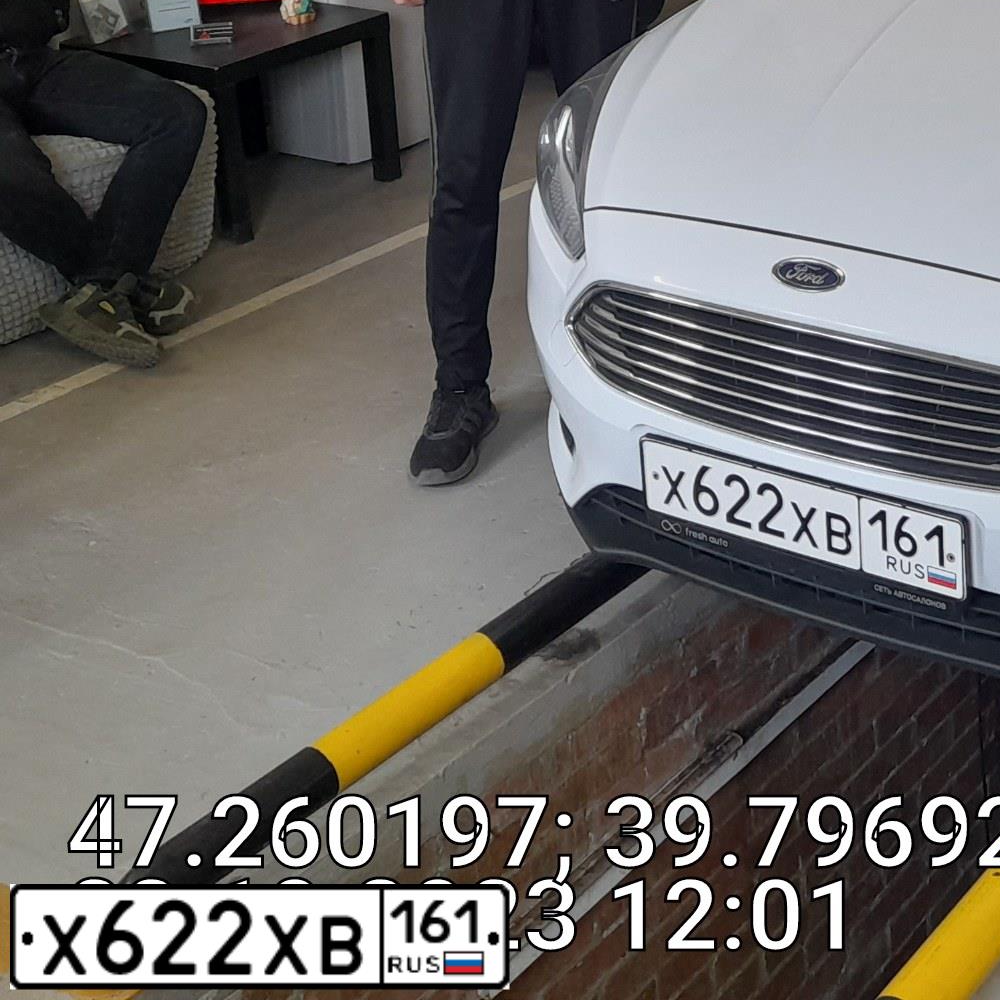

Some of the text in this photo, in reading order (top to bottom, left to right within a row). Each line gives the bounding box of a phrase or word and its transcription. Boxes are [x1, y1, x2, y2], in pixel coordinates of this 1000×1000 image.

[785, 263, 830, 285] Ford
[661, 465, 945, 567] Х622ХВ 161
[685, 527, 729, 548] fresh auto
[886, 555, 926, 580] RUS
